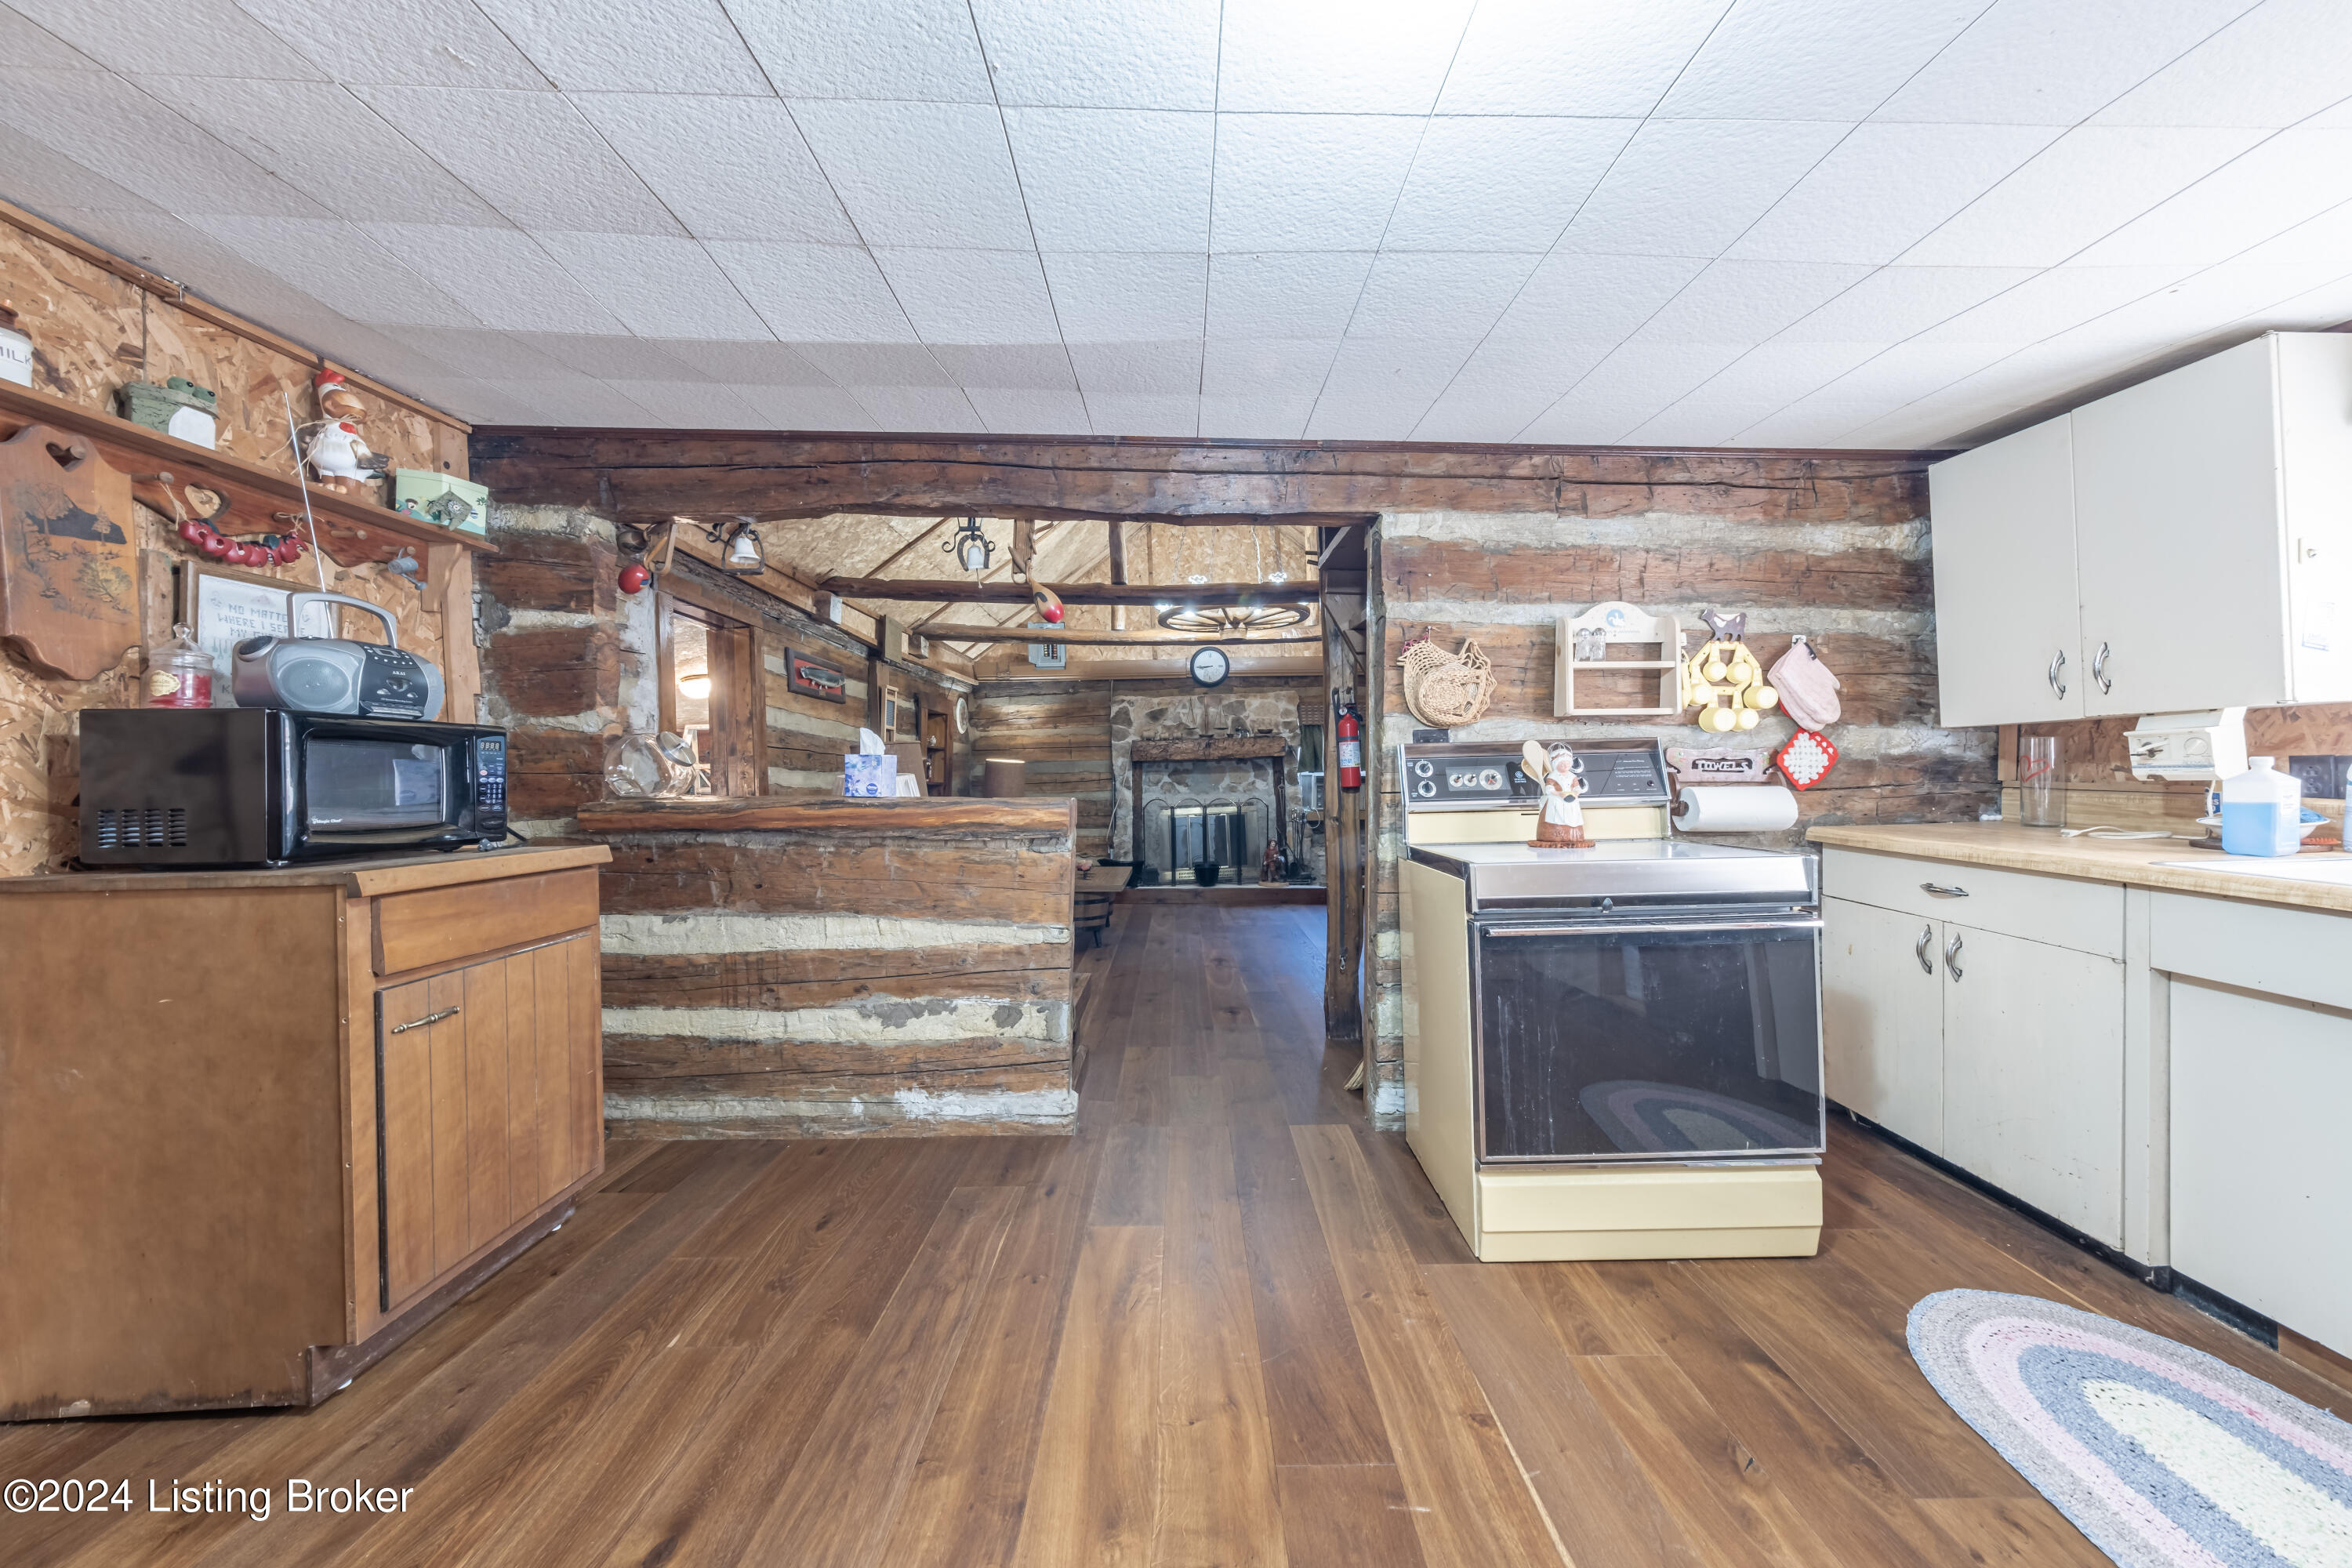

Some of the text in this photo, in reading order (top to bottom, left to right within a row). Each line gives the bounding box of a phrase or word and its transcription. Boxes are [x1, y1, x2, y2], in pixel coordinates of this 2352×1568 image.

[0, 346, 31, 367] ILK
[228, 603, 288, 622] NO MATTE
[218, 613, 256, 628] WHERE
[230, 627, 247, 638] MY
[1696, 760, 1749, 771] TOWELS
